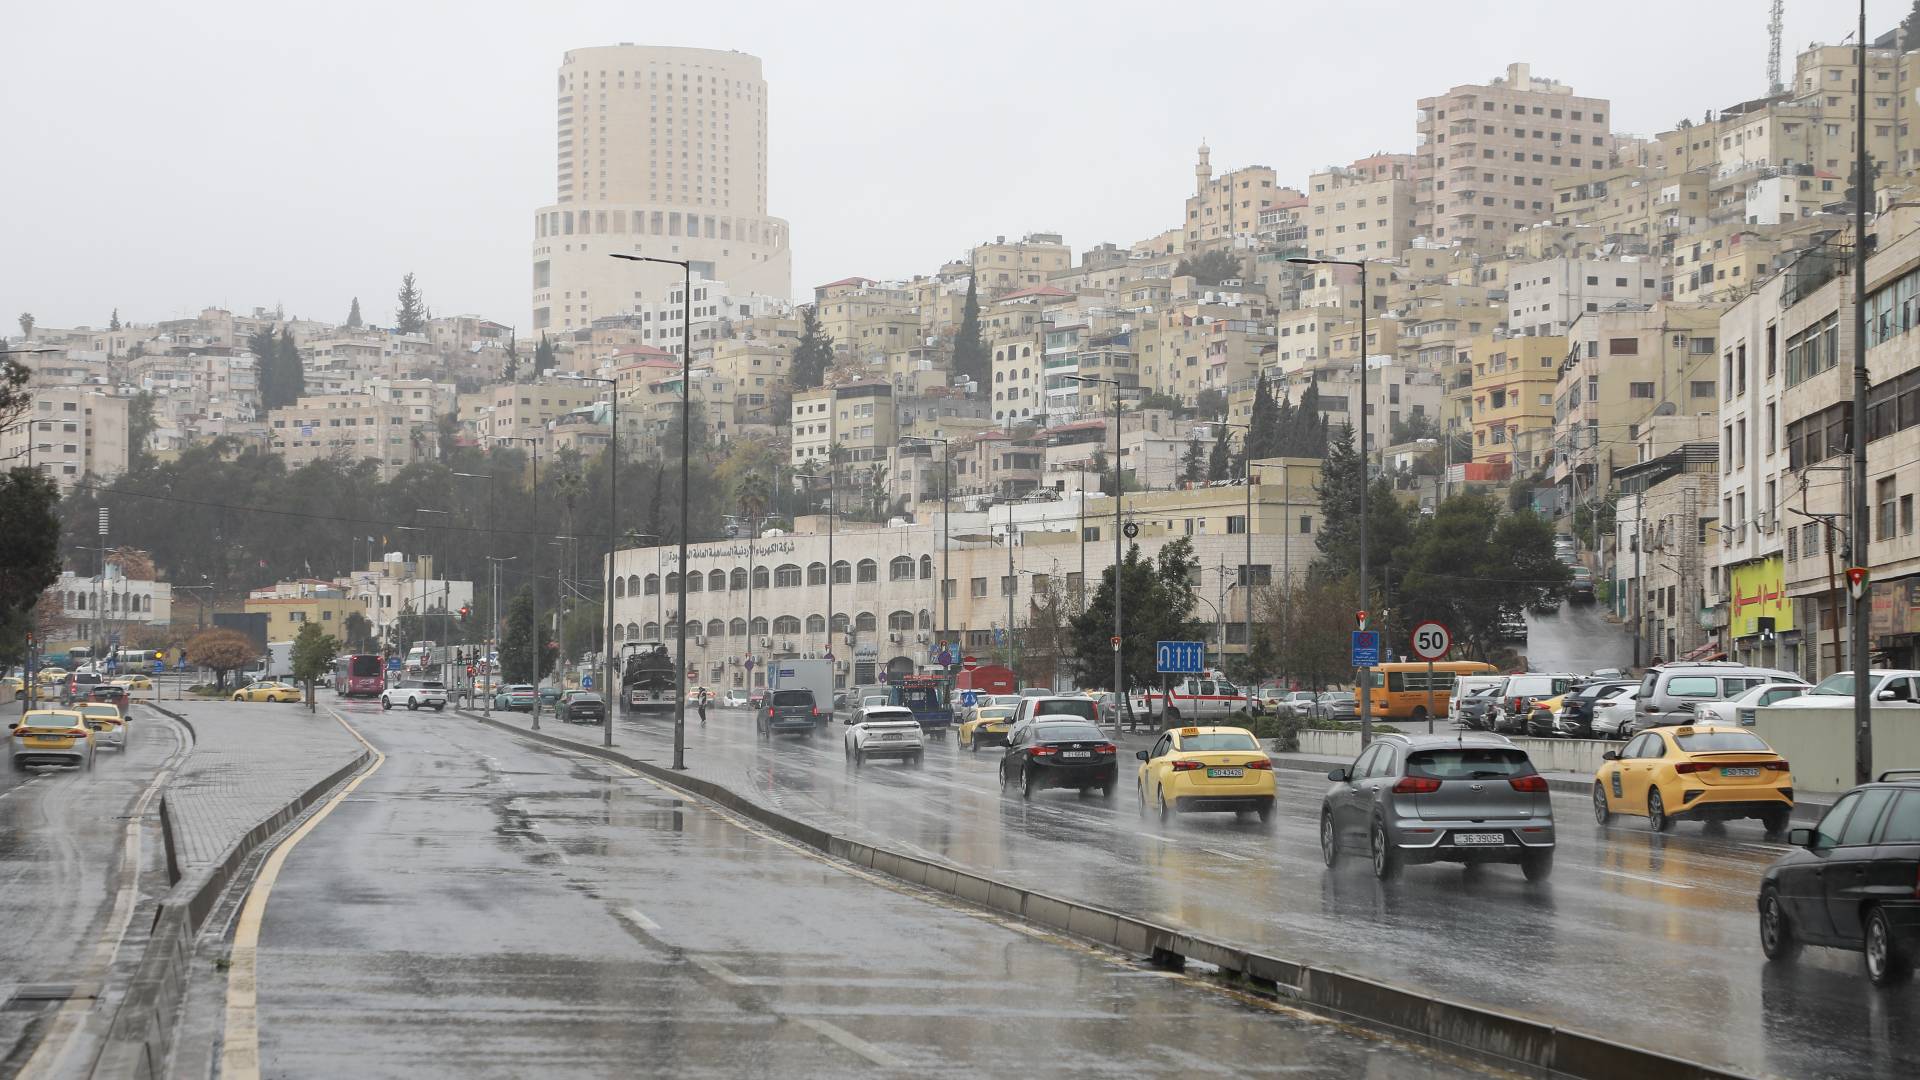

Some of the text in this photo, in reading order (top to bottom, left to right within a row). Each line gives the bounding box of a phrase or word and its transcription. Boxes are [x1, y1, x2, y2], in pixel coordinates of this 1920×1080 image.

[756, 542, 778, 557] الكهرباء
[778, 540, 795, 555] شركة
[1418, 631, 1444, 650] 50
